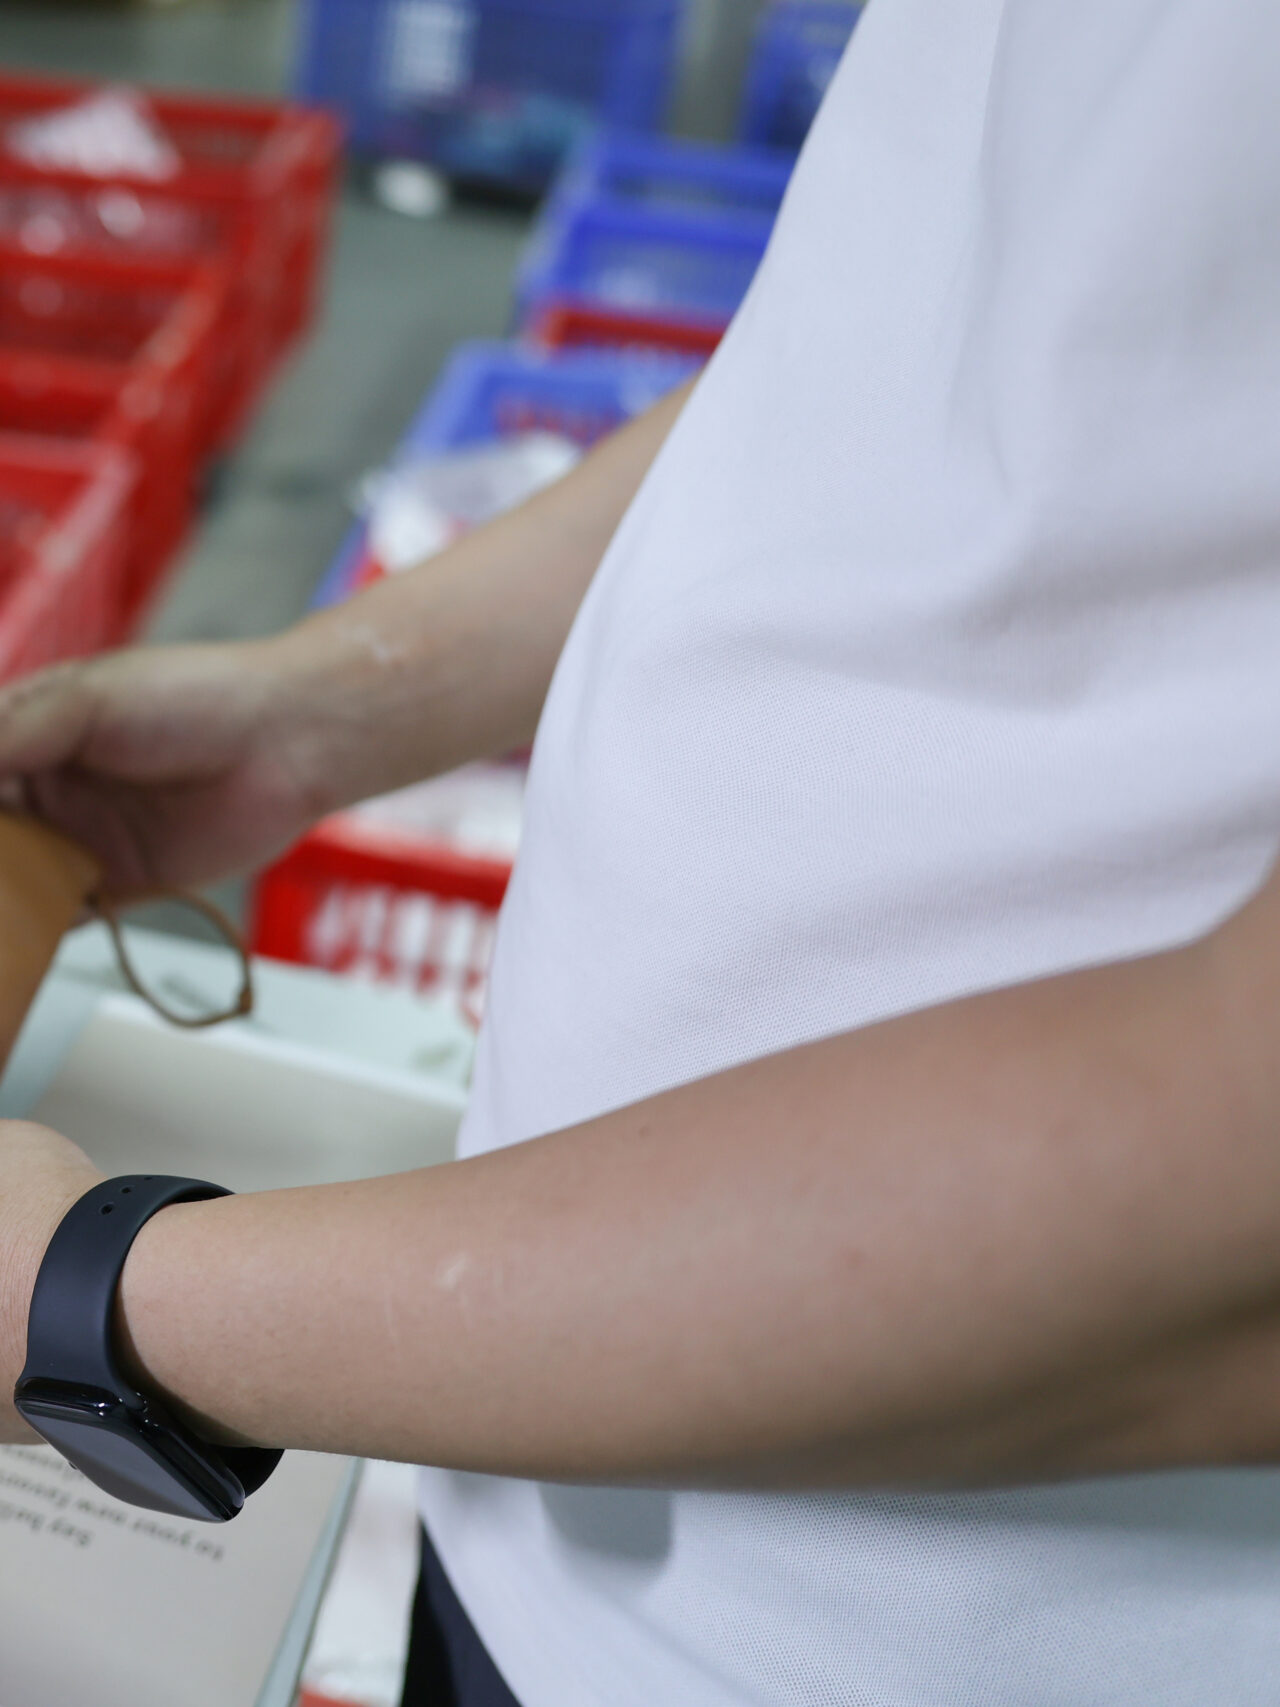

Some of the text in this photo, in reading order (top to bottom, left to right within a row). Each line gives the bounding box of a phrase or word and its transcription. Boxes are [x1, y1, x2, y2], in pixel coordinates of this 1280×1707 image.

[76, 1498, 128, 1525] new
[48, 1514, 92, 1548] Say
[131, 1517, 193, 1546] your
[195, 1539, 223, 1561] to
